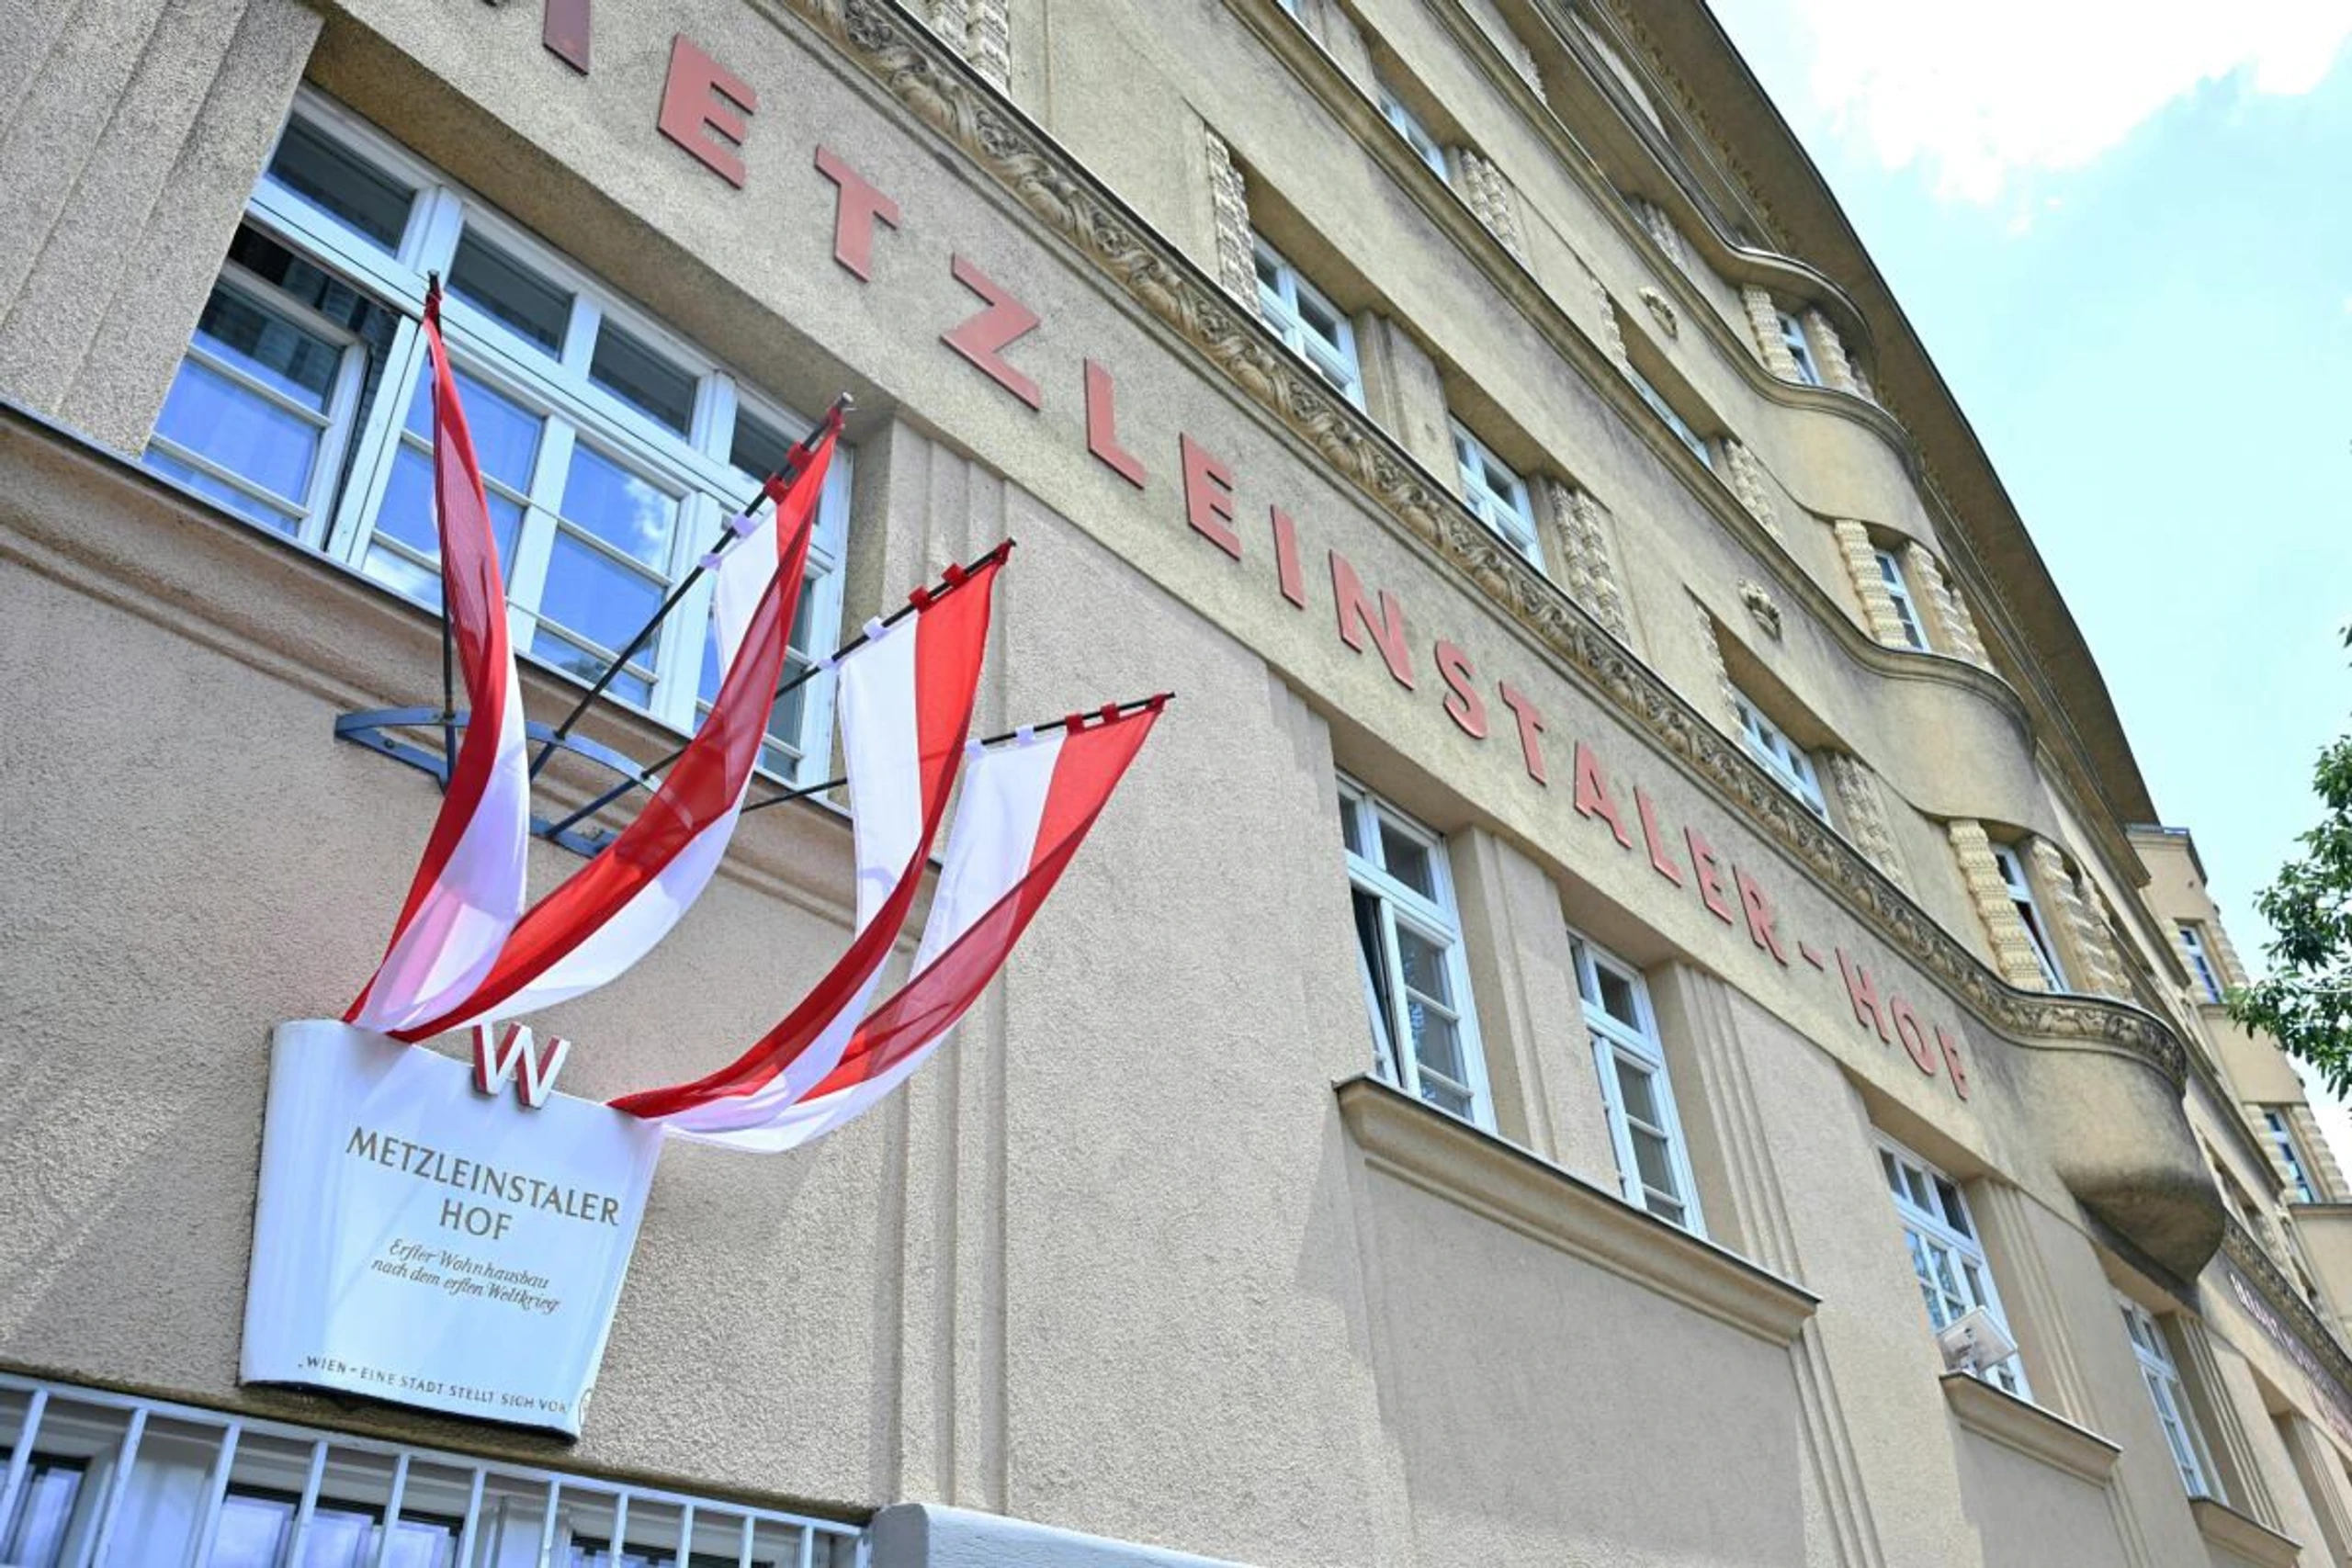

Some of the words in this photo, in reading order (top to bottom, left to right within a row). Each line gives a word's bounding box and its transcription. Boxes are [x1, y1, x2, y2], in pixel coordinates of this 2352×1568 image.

[481, 0, 1971, 1101] ETZLEINSTALER-HOF
[471, 1019, 571, 1110] W
[345, 1126, 619, 1226] METZLEINSTALER
[439, 1198, 513, 1240] HOF
[371, 1258, 408, 1278] nach
[409, 1267, 441, 1285] dem
[487, 1282, 561, 1314] Weltkrieg
[439, 1250, 549, 1289] Wohnhausbau
[399, 1375, 444, 1395] STADT
[448, 1384, 494, 1403] STELLT
[501, 1394, 534, 1411] SICH
